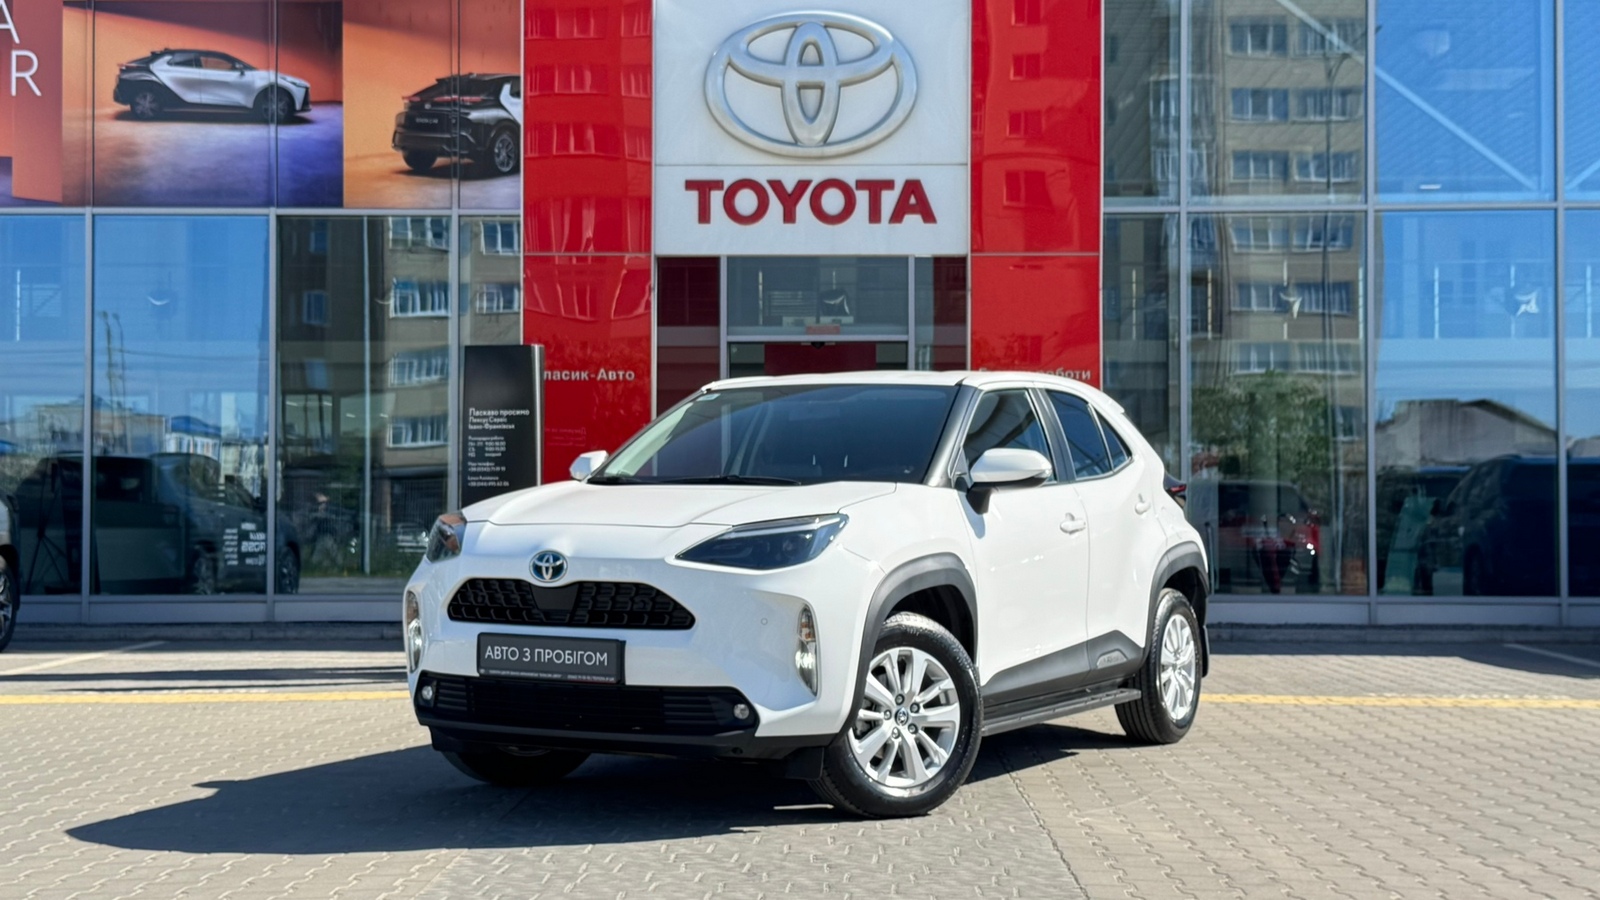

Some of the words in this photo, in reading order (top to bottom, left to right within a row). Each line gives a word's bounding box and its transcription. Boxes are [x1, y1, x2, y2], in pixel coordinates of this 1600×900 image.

[685, 178, 937, 225] TOYOTA
[543, 367, 635, 381] ласик-Авто
[485, 645, 520, 661] АВТО
[534, 648, 608, 666] ПРОБІГОМ
